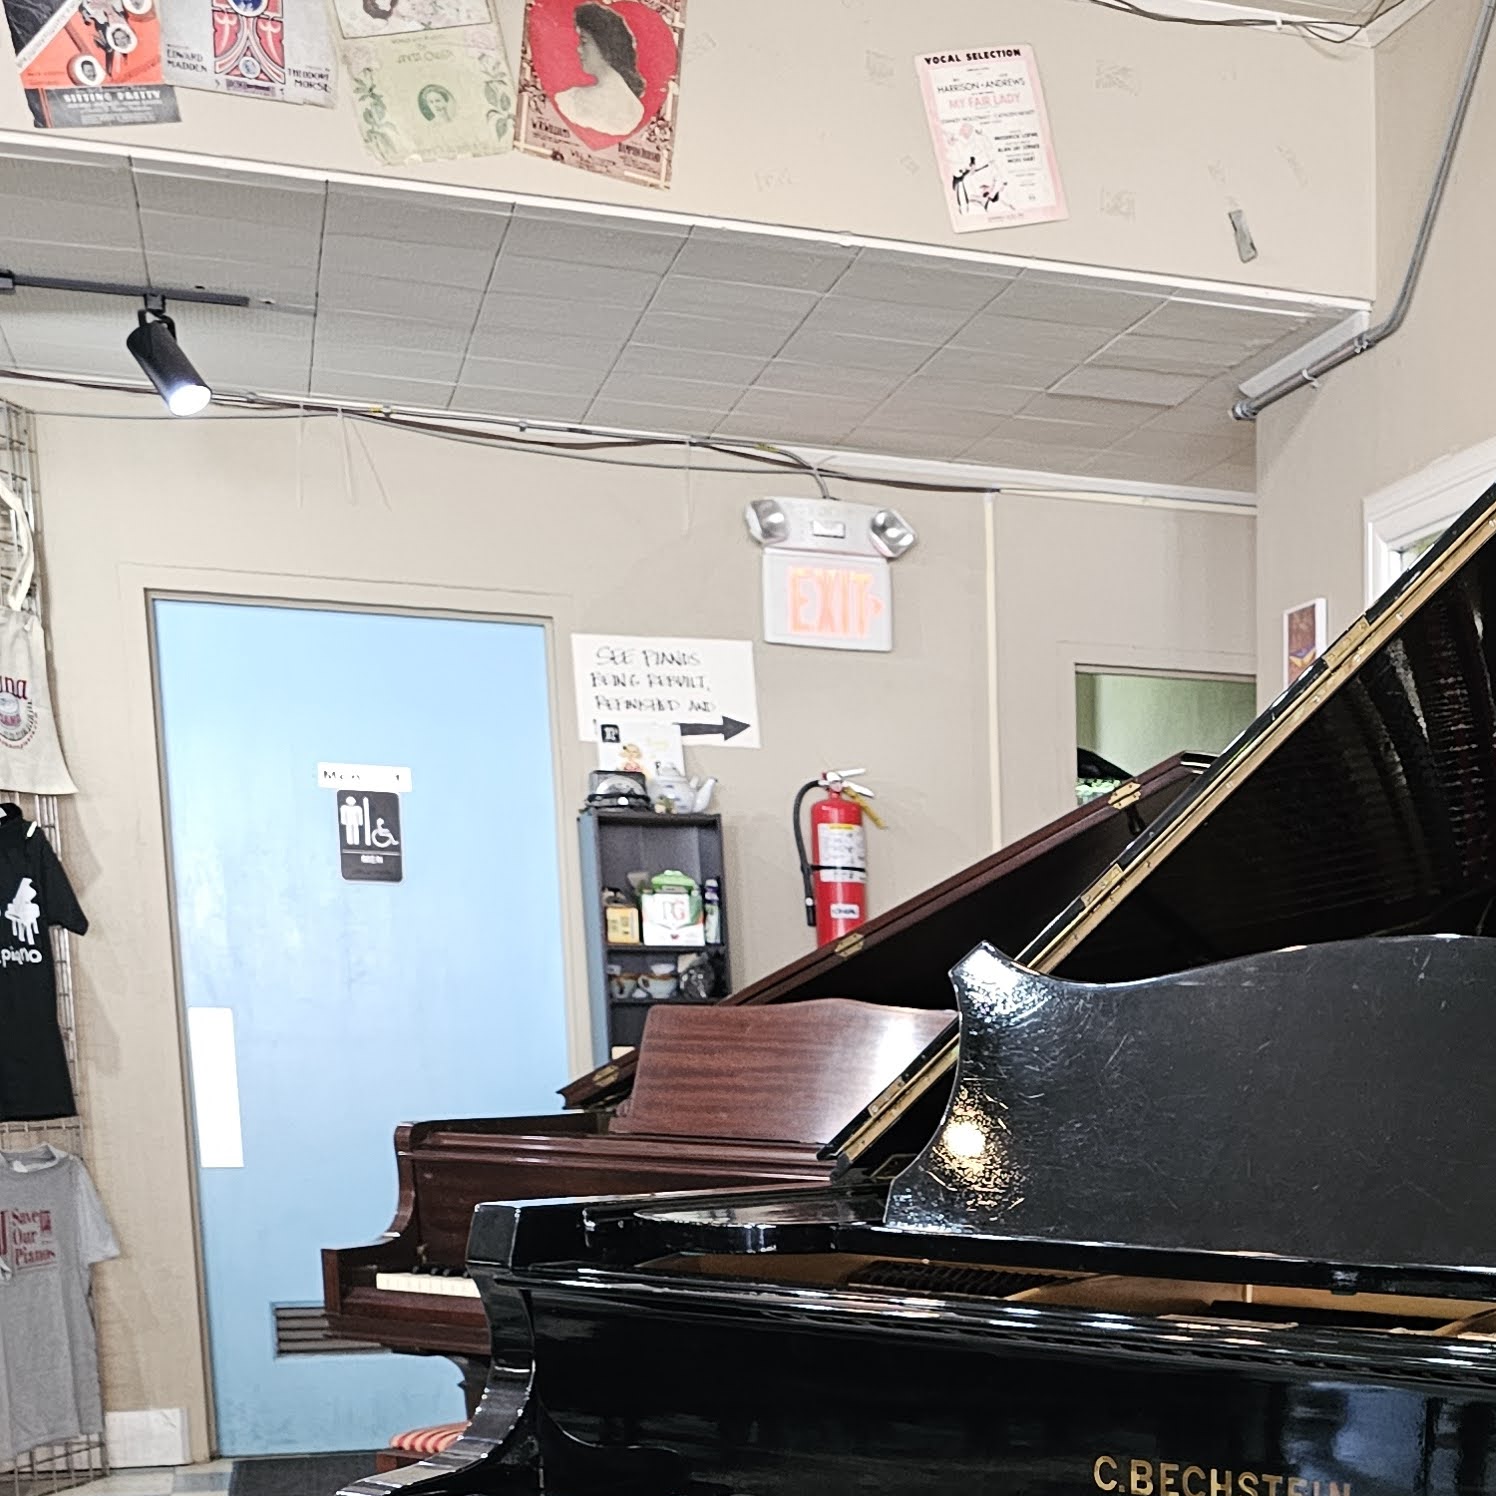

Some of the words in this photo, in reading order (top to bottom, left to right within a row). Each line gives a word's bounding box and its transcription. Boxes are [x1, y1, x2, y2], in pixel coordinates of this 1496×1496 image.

[924, 54, 961, 65] VOCAL
[966, 49, 1022, 61] SELECTION
[937, 82, 980, 94] HARRISON
[985, 77, 1026, 88] ANDREWS
[949, 97, 967, 109] MY
[994, 92, 1021, 105] LADY
[789, 568, 873, 636] EXIT
[596, 645, 636, 666] SEE
[688, 700, 717, 712] AND
[1, 945, 43, 968] piano
[13, 1228, 37, 1245] Our
